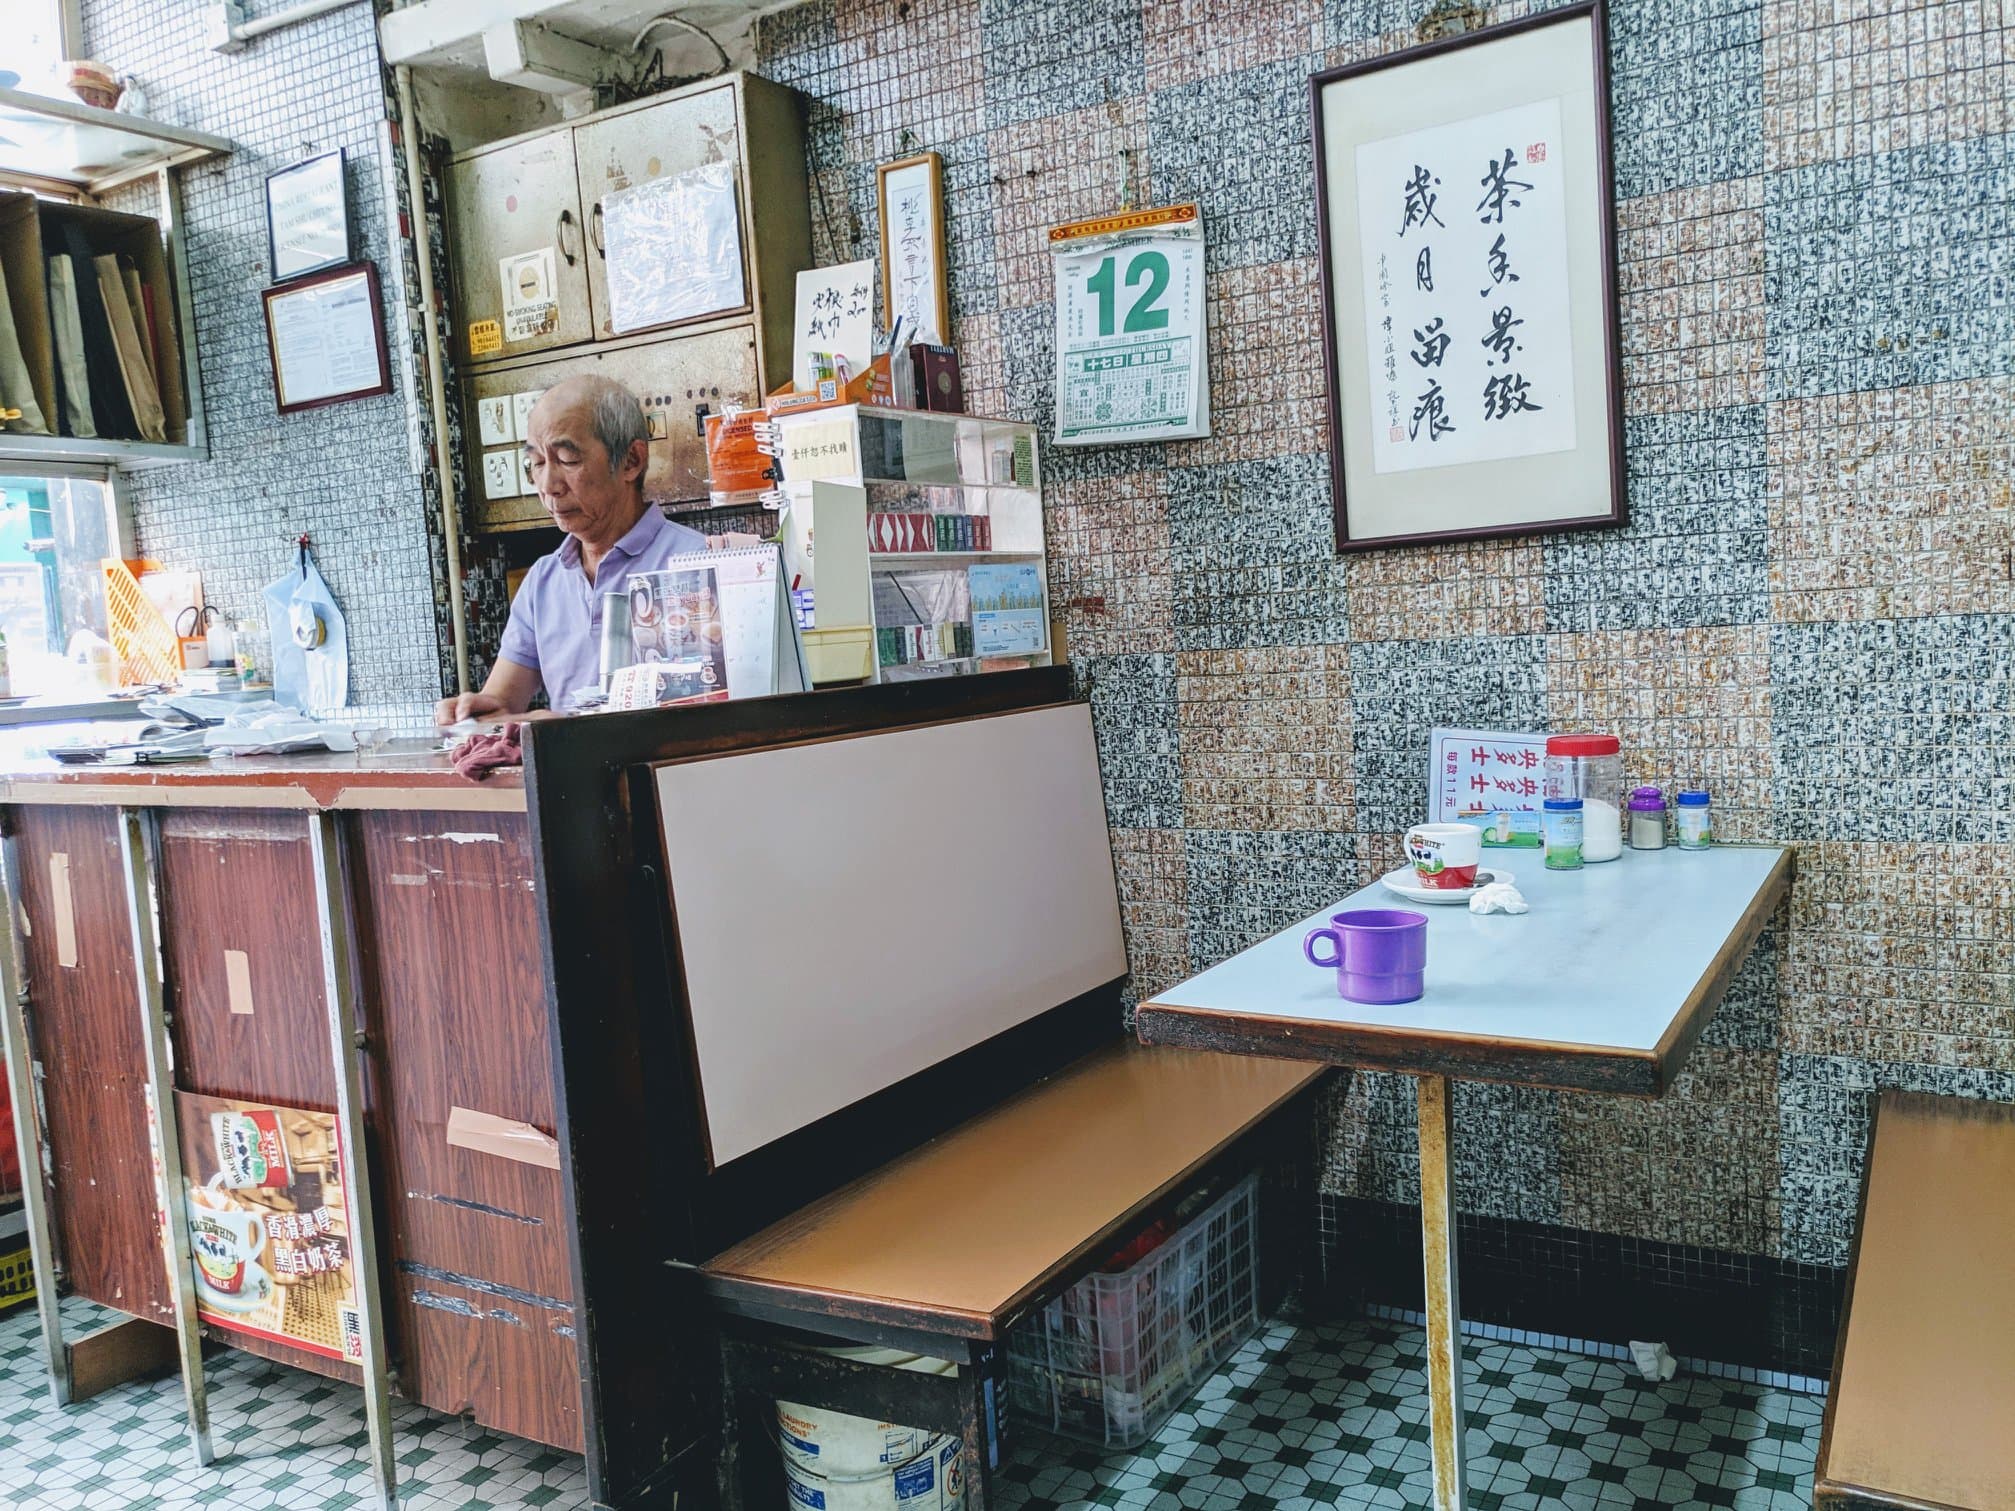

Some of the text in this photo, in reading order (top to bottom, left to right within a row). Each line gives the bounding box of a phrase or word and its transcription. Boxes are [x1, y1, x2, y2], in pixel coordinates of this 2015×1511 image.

[1086, 251, 1171, 337] 12
[1087, 349, 1169, 371] 十七日 星期四
[1471, 745, 1563, 772] 央多士
[269, 1129, 281, 1169] MILK
[265, 1205, 334, 1240] 香滑濃厚
[274, 1241, 344, 1275] 黑白奶茶
[208, 1274, 231, 1290] MILK
